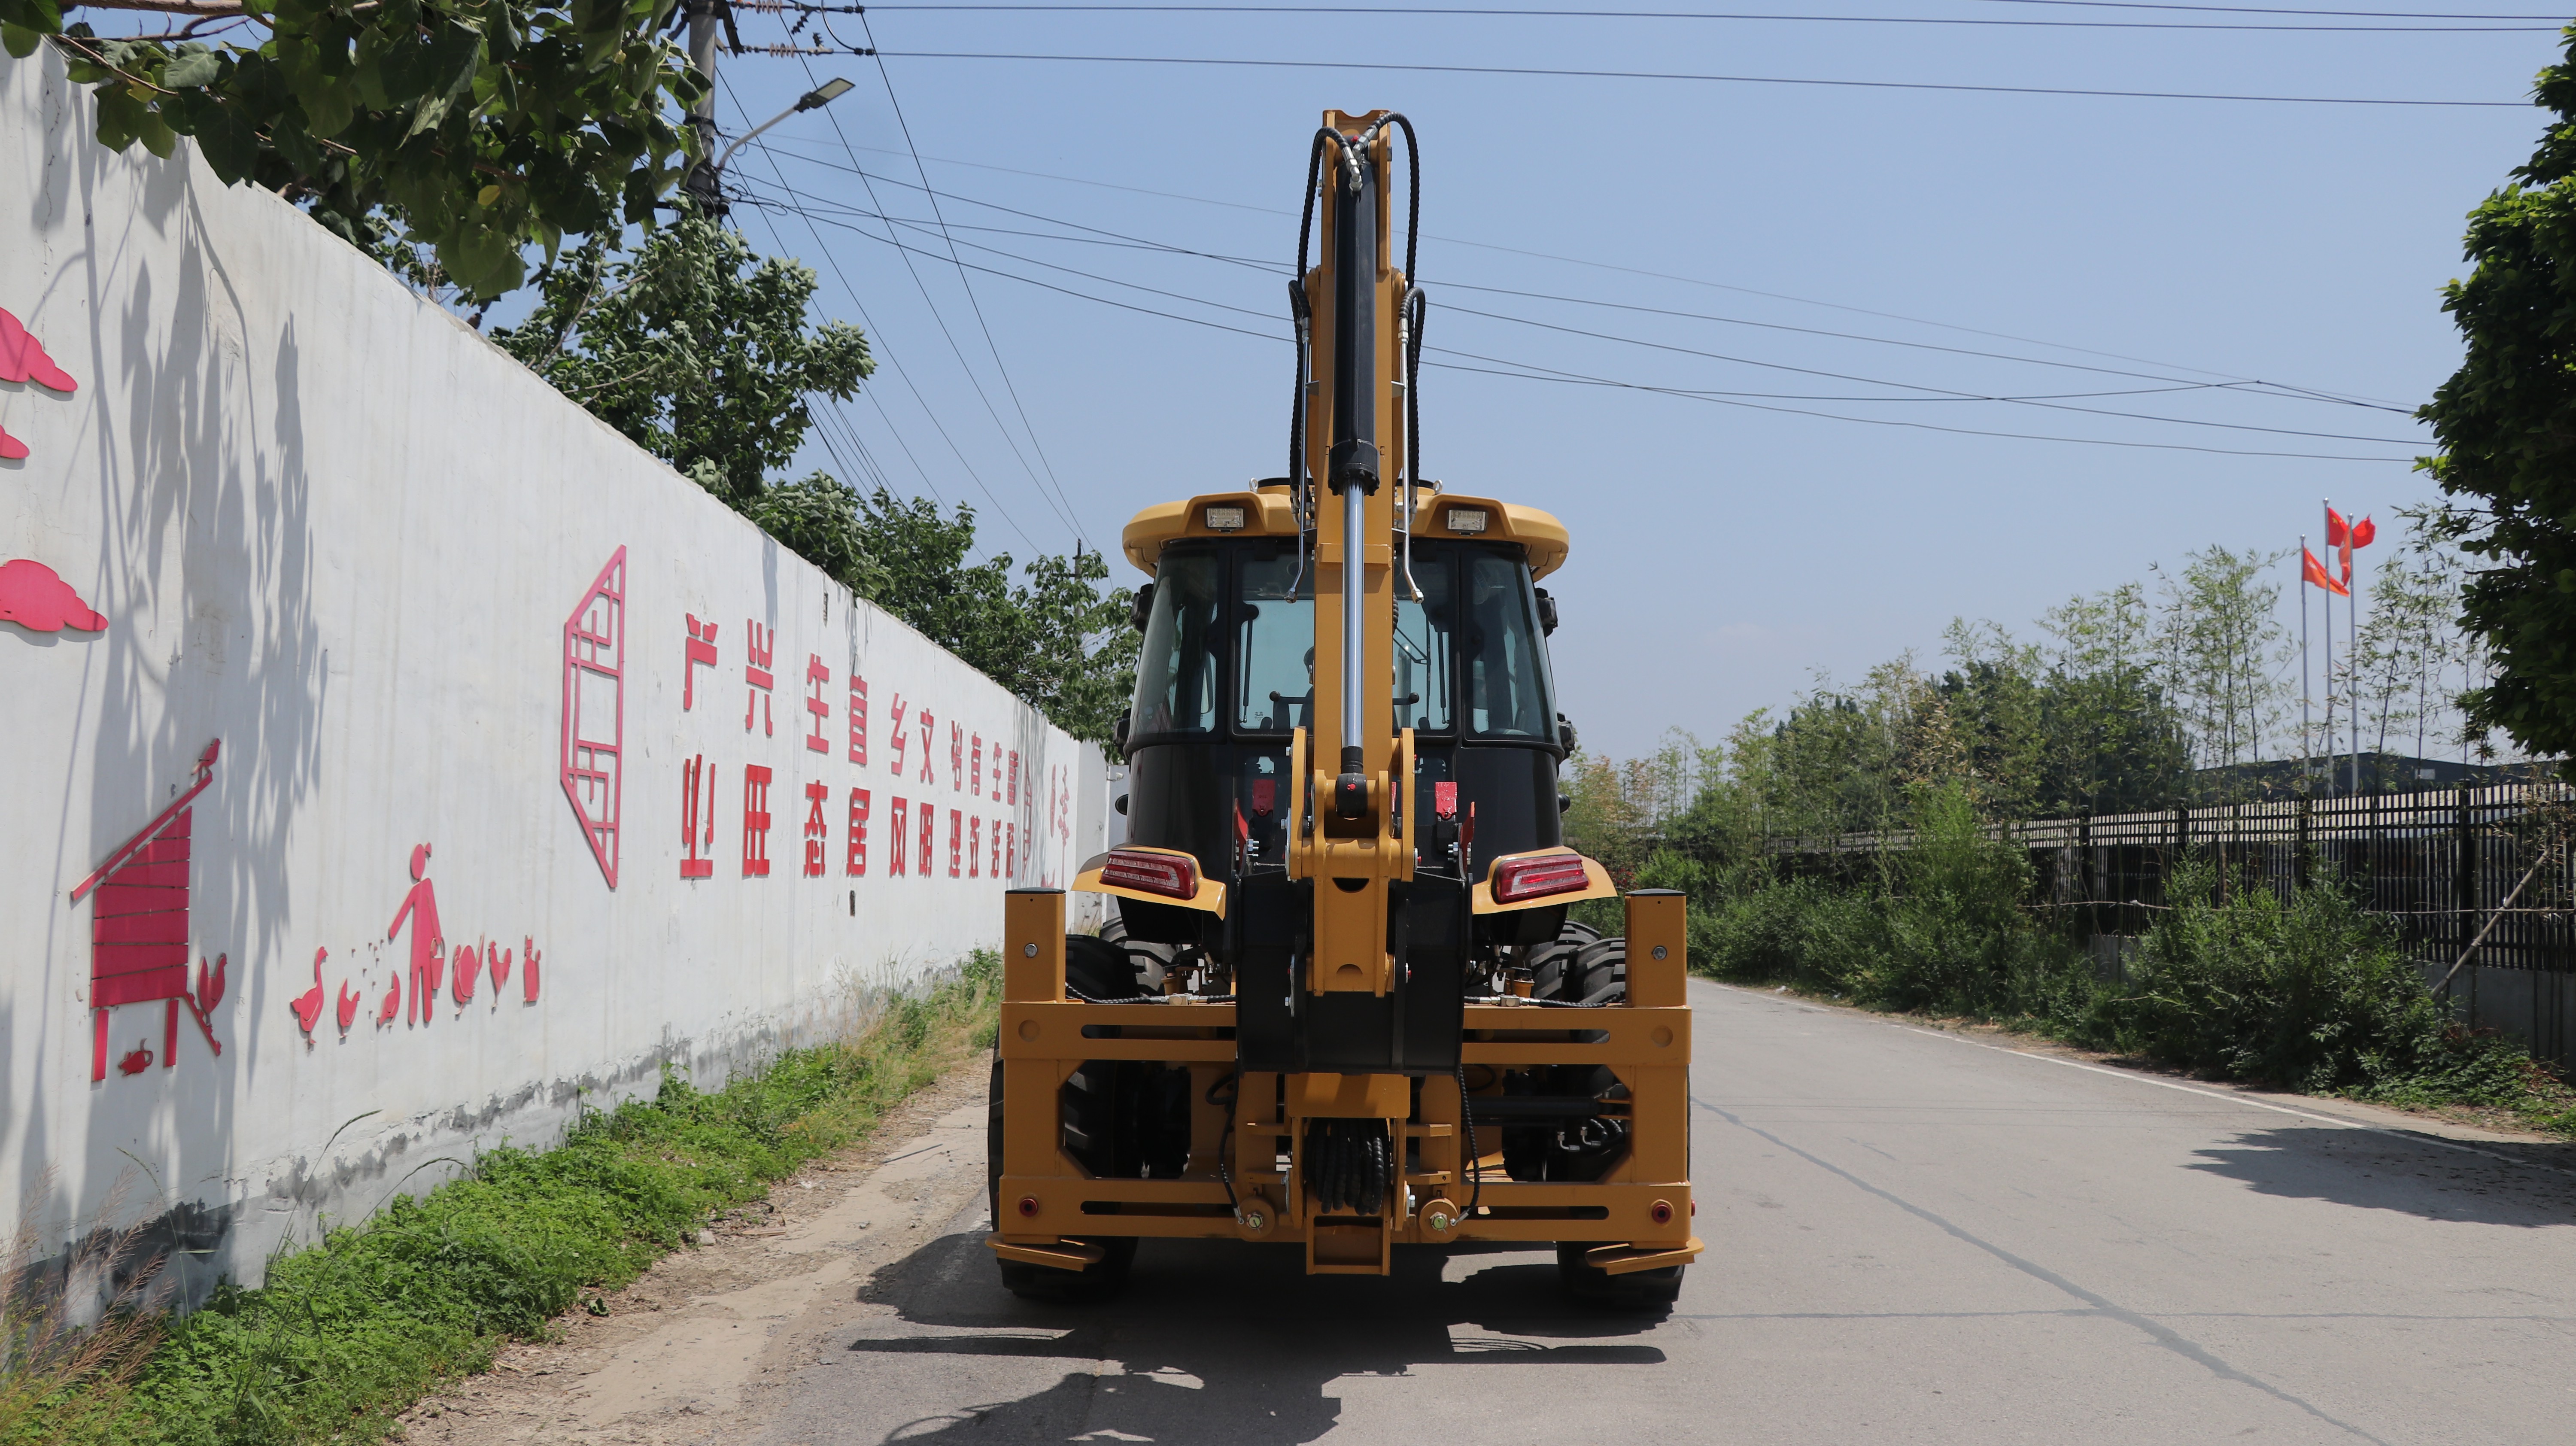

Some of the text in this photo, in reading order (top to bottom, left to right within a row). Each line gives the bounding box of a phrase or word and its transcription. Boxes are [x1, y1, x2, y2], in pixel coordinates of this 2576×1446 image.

[680, 612, 718, 878] 产业
[742, 618, 774, 876] 兴旺
[804, 653, 829, 876] 生态
[846, 674, 871, 876] 宜居
[890, 693, 908, 876] 乡风
[919, 708, 934, 877] 文明
[949, 720, 962, 877] 治理
[969, 731, 981, 877] 有效
[990, 741, 1002, 878] 生活
[1006, 750, 1018, 878] 富裕
